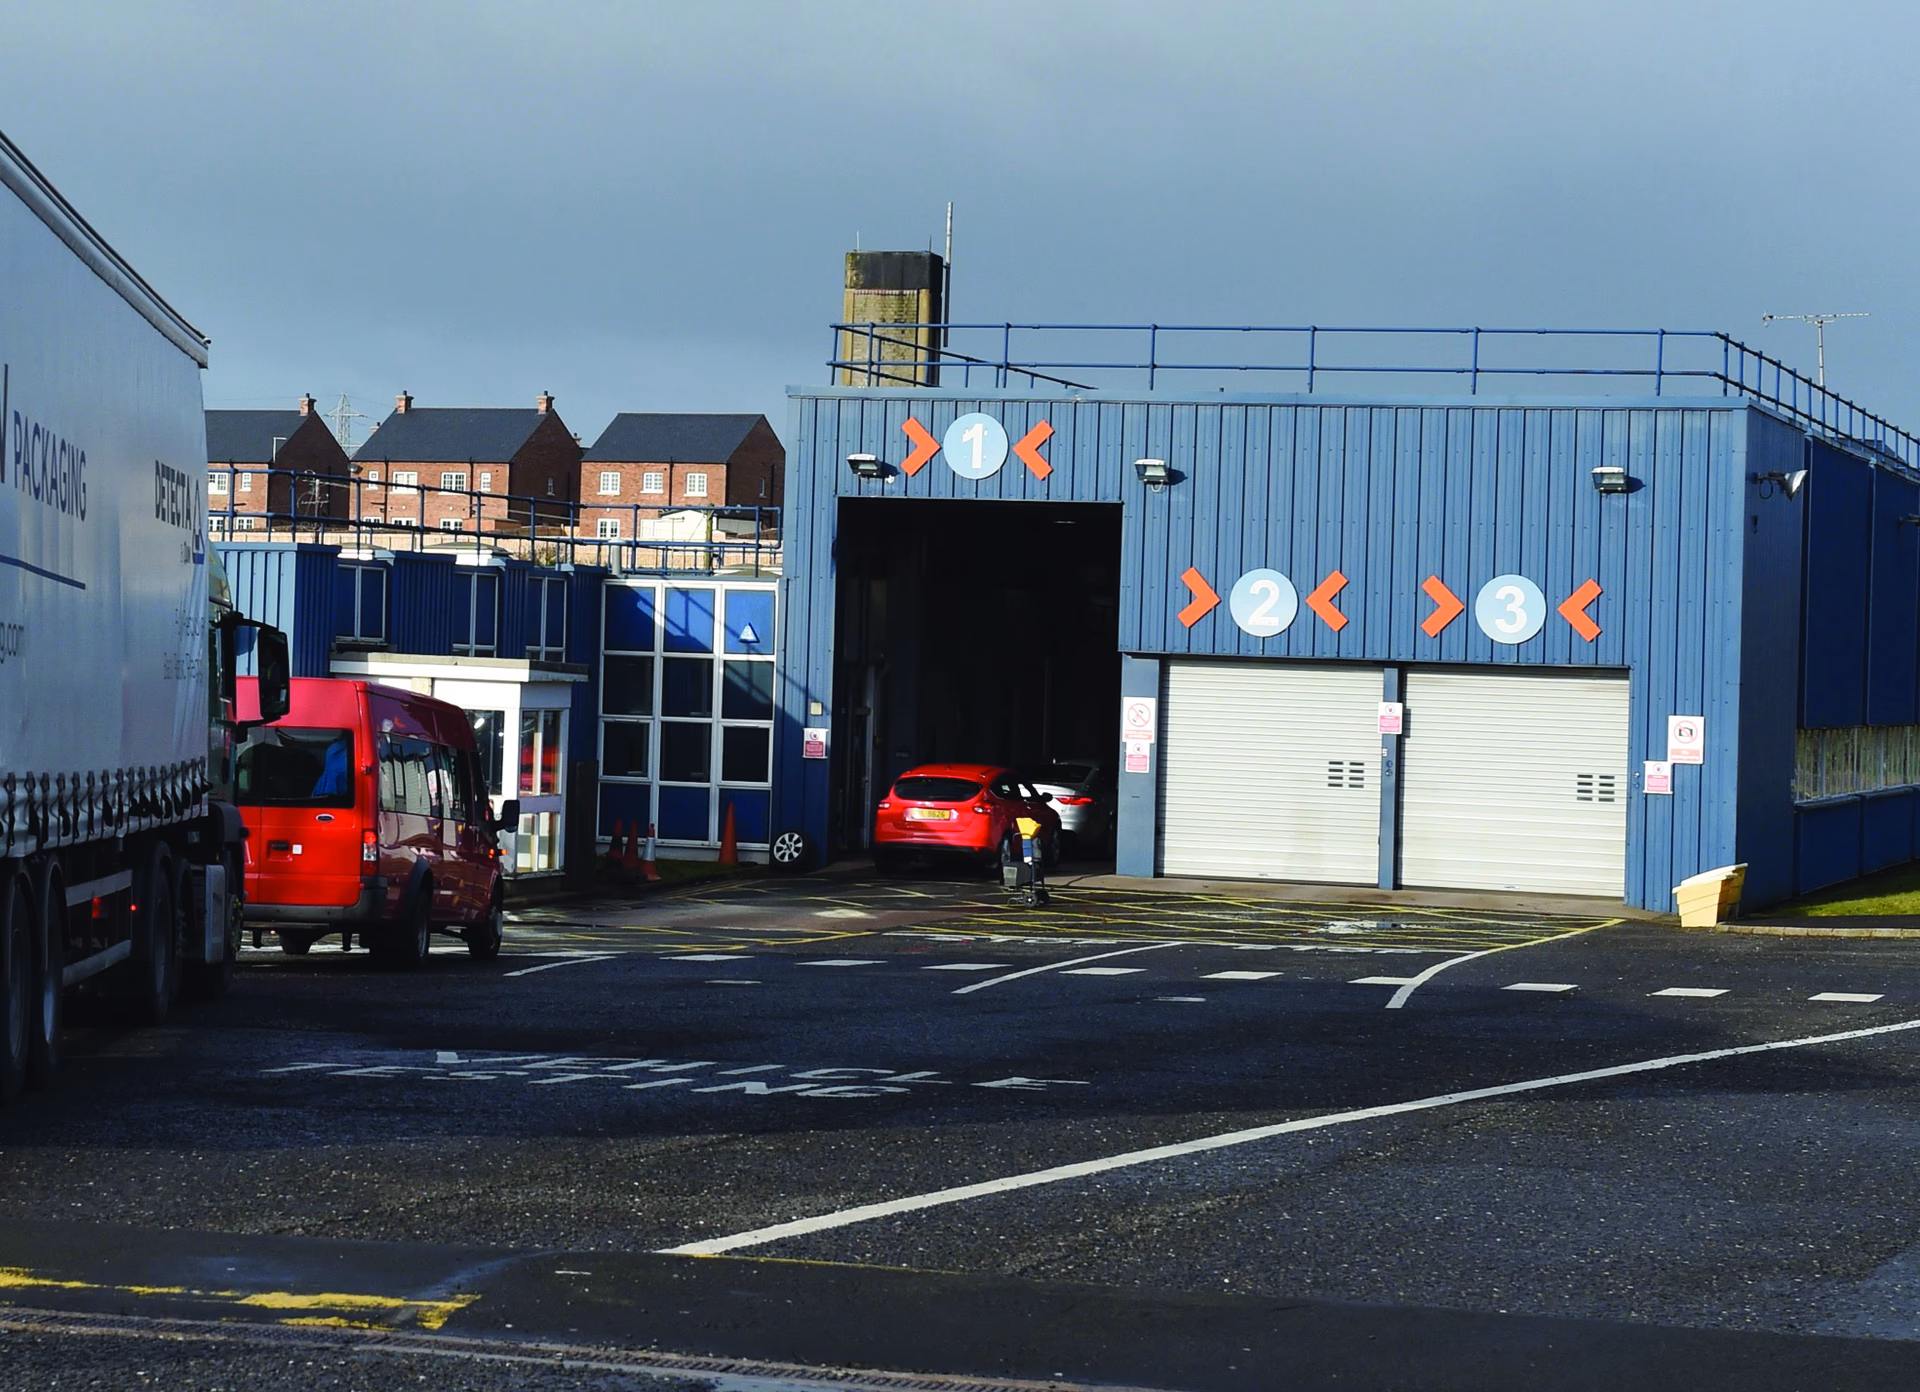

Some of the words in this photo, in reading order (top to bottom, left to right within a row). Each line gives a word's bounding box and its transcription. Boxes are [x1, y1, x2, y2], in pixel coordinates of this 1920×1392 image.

[14, 410, 87, 521] PACKAGING
[962, 423, 983, 469] 1
[1247, 579, 1280, 627] 2
[1495, 585, 1527, 634] 3
[257, 1062, 913, 1098] TESTING
[433, 1051, 1091, 1091] VEHICLE
